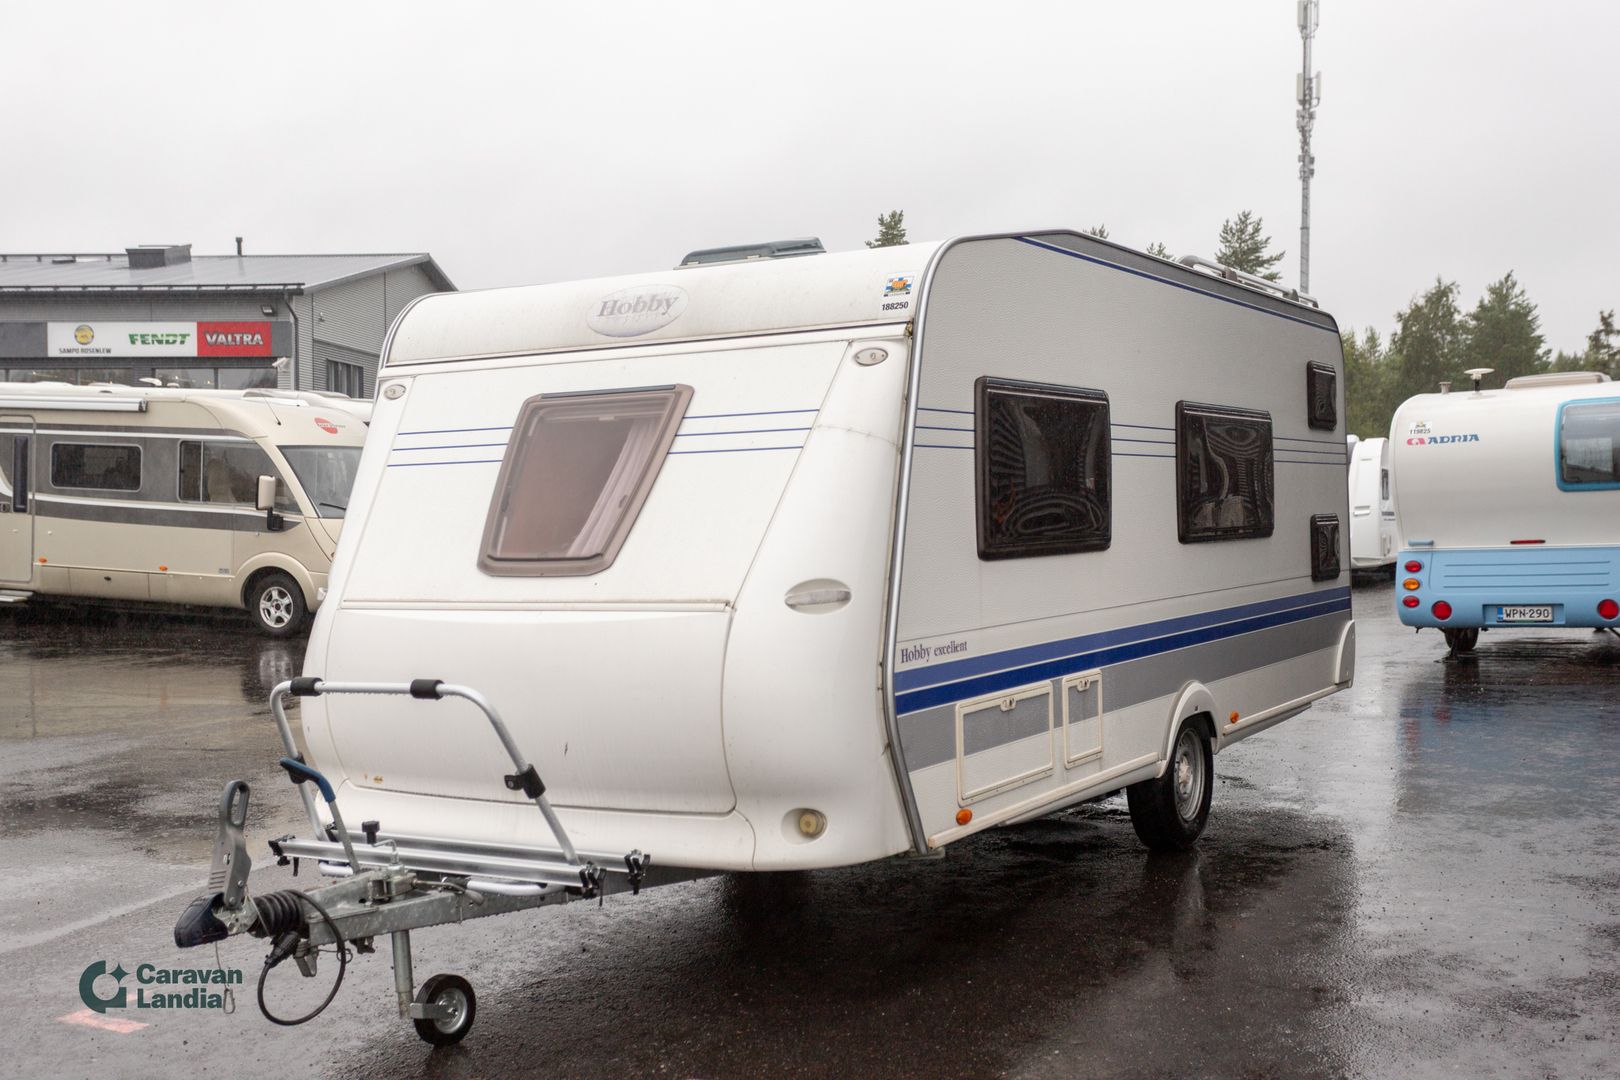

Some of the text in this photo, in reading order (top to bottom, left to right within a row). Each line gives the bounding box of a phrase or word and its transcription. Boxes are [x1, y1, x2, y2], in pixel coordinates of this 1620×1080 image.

[596, 293, 680, 317] Hobby
[881, 301, 909, 311] 188250
[128, 333, 191, 346] FENDT
[204, 332, 264, 347] VALTRA
[1427, 433, 1480, 445] ADRIA
[1504, 608, 1550, 619] WPN-290
[901, 640, 968, 664] Hobby excellent
